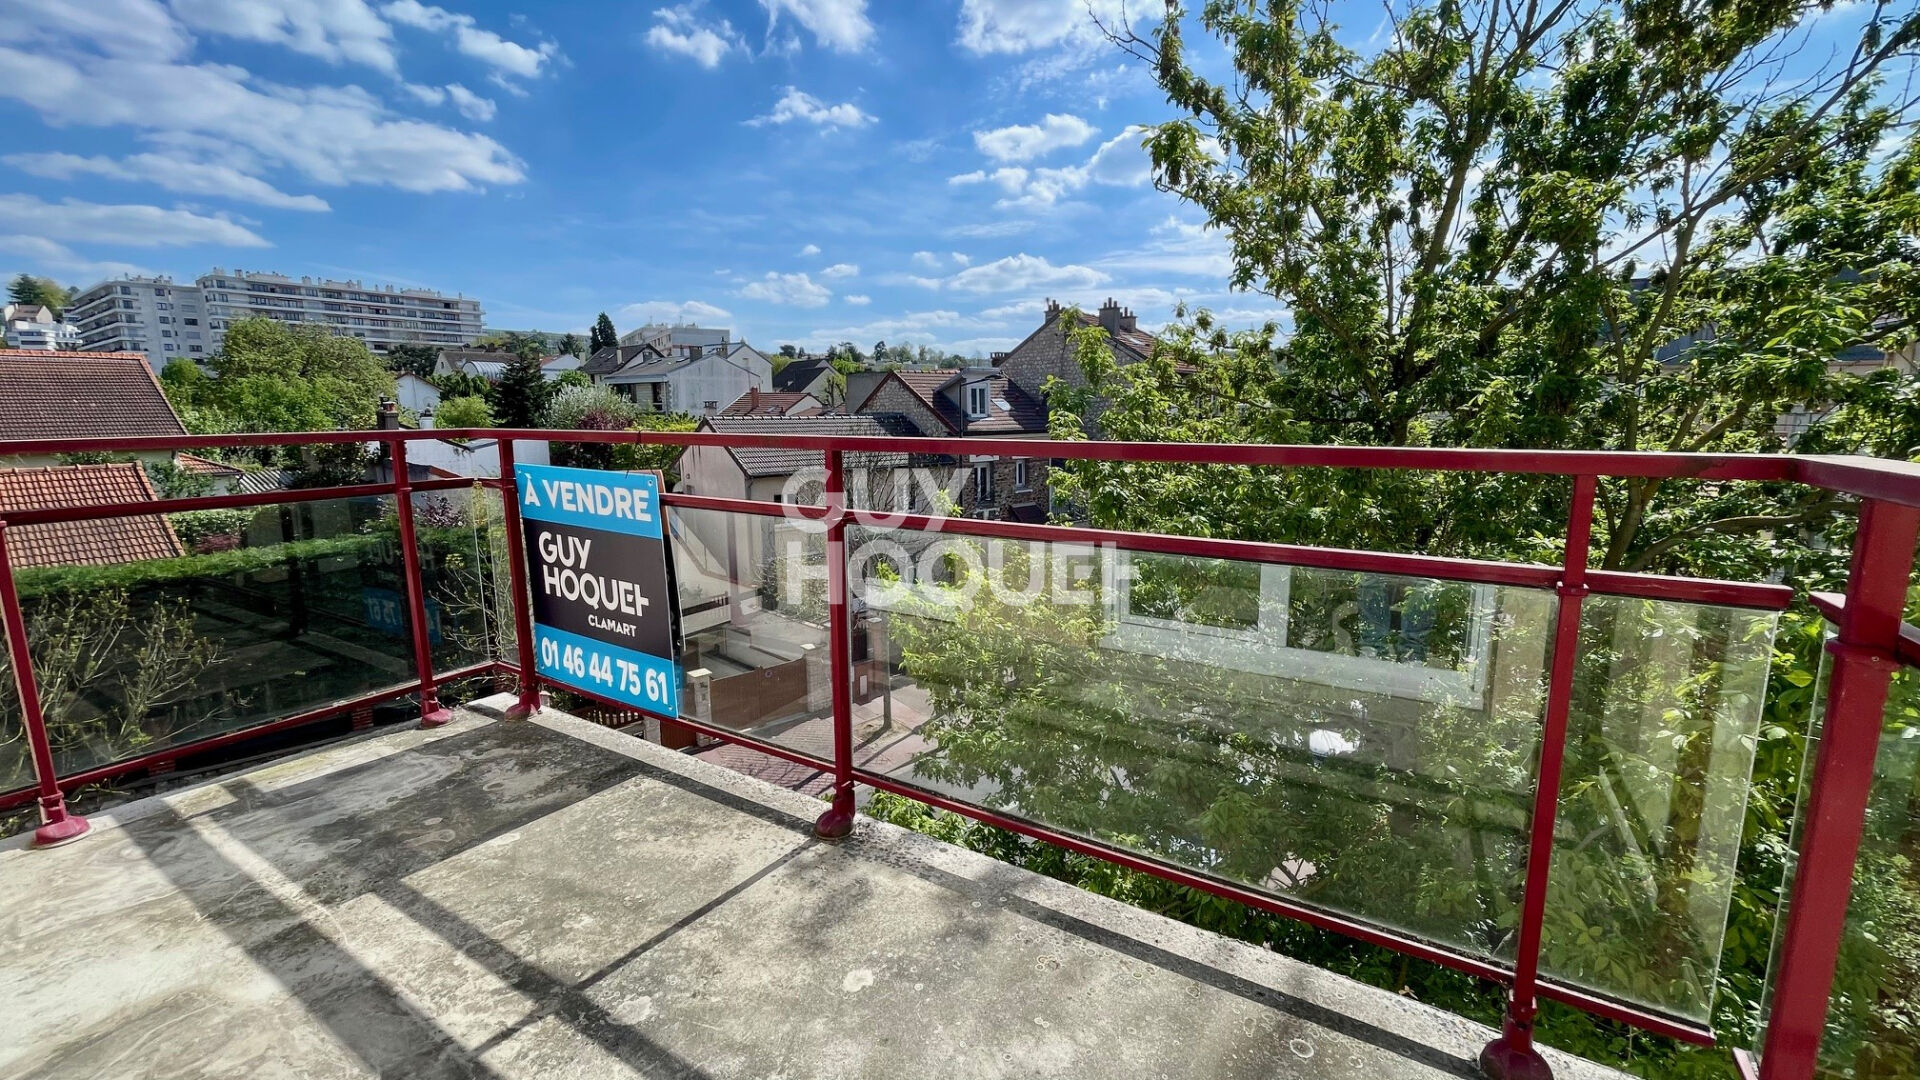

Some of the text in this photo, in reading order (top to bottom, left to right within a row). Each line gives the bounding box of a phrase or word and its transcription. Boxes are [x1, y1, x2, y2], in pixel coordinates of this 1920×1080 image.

[524, 473, 652, 522] À VENDRE
[538, 531, 592, 569] GUY
[588, 614, 637, 637] CLAMART
[541, 637, 669, 705] 01 46 44 75 61
